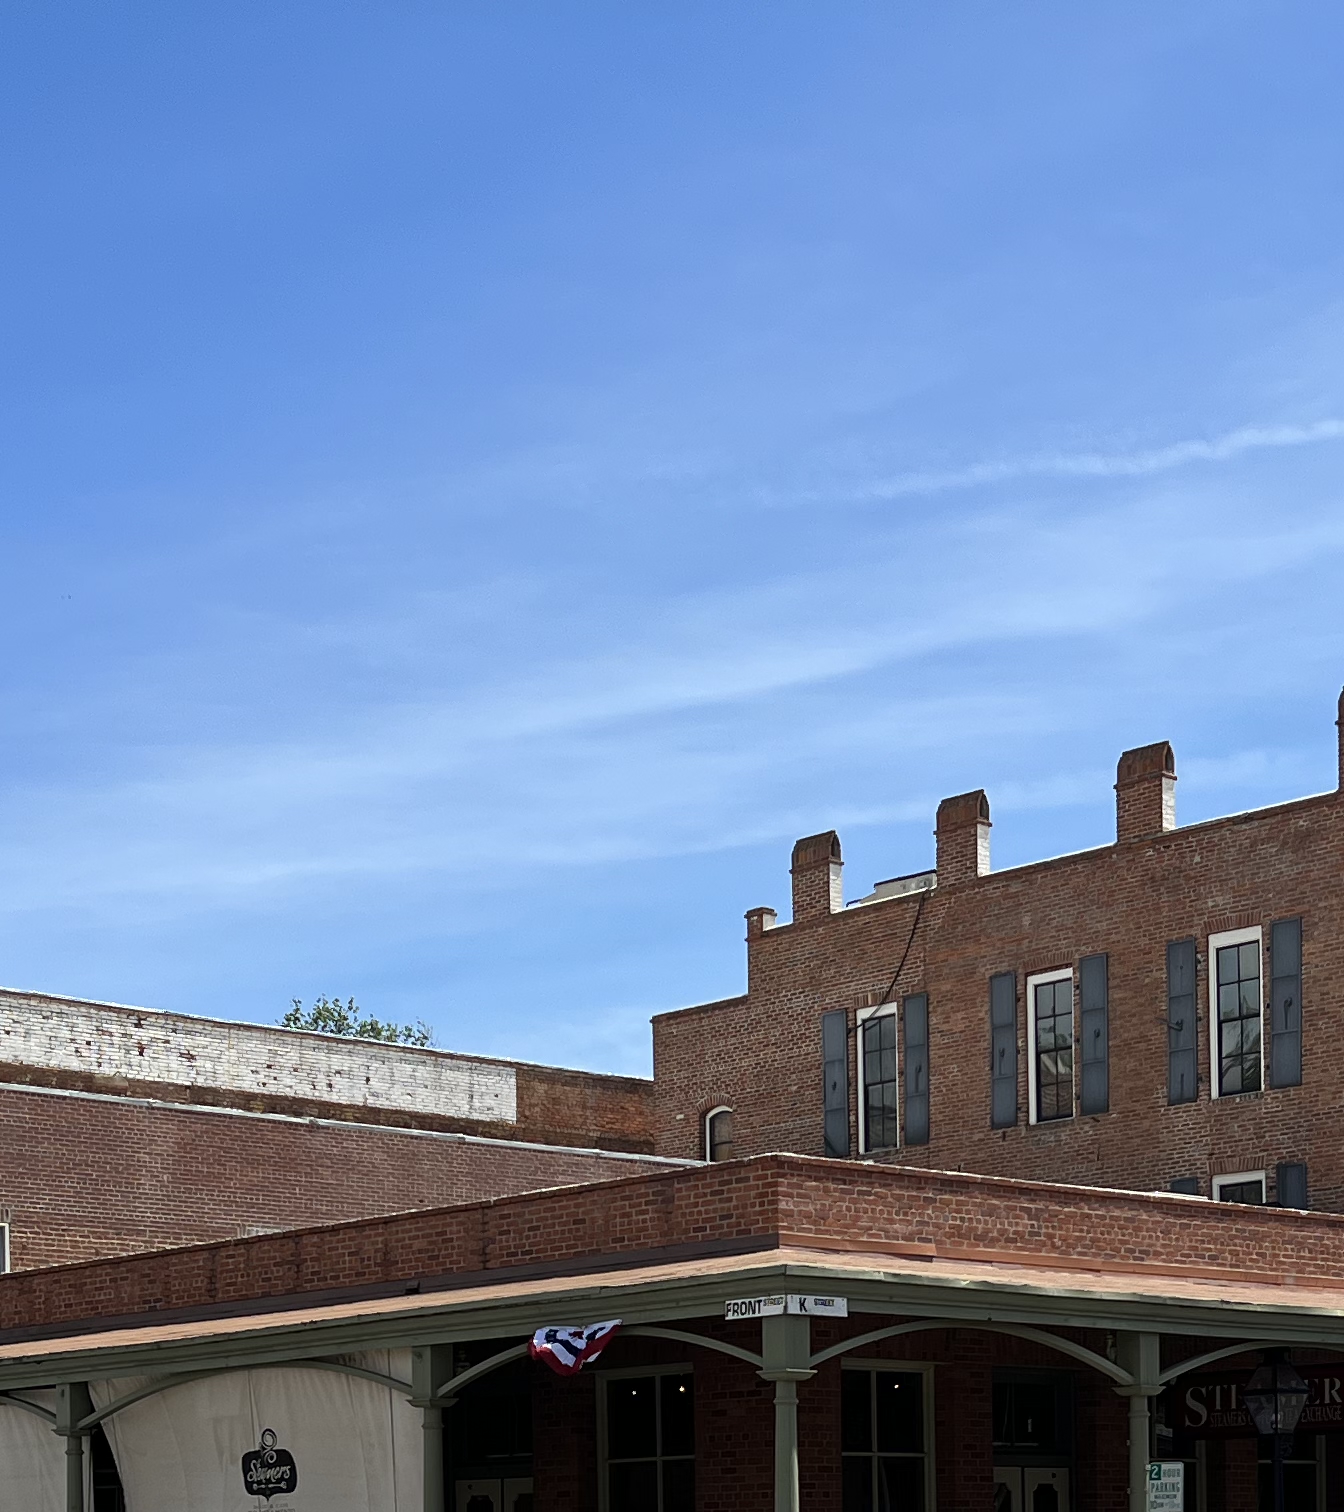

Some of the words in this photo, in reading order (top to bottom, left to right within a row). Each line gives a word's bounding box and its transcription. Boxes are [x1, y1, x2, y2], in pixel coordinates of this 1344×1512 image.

[725, 1299, 763, 1318] FRONT
[799, 1296, 808, 1313] K
[1301, 1404, 1343, 1423] EXCHANGE
[1151, 1465, 1159, 1479] 2
[1162, 1468, 1181, 1478] HOUR
[1151, 1481, 1181, 1494] PARKING
